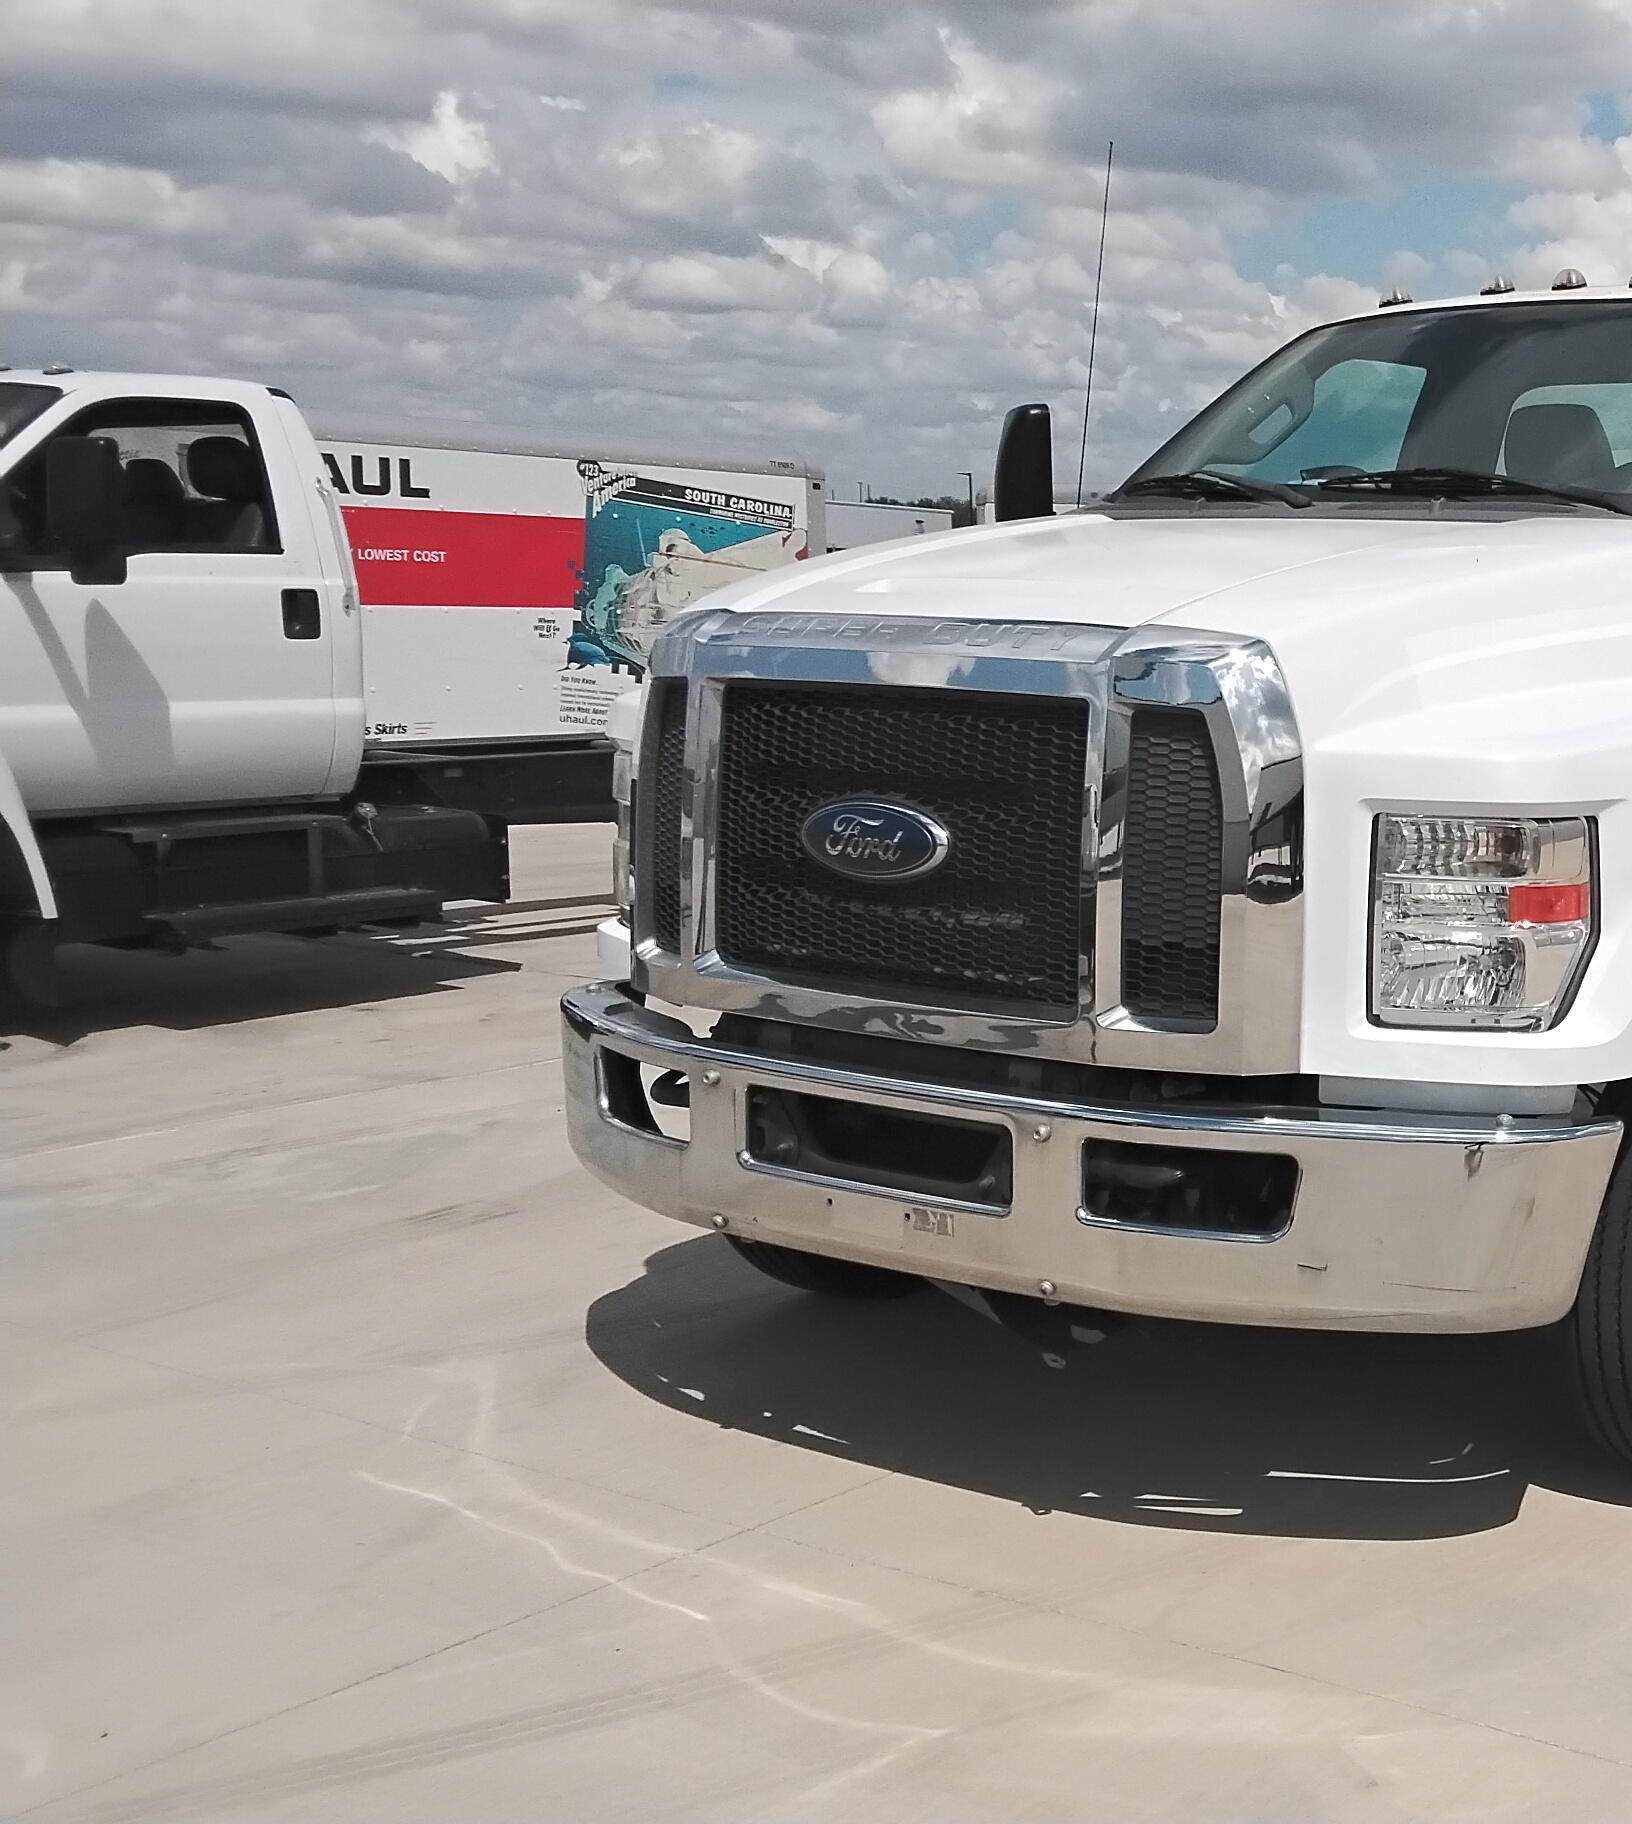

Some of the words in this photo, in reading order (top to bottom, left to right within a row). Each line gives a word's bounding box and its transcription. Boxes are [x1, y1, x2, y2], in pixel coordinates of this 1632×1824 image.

[685, 488, 726, 506] SOUTH
[729, 496, 791, 518] CAROLINA
[358, 548, 410, 561] LOWEST
[413, 550, 446, 562] COST
[922, 622, 1088, 652] DUTY
[374, 722, 408, 736] Skirts
[825, 814, 904, 862] Ford
